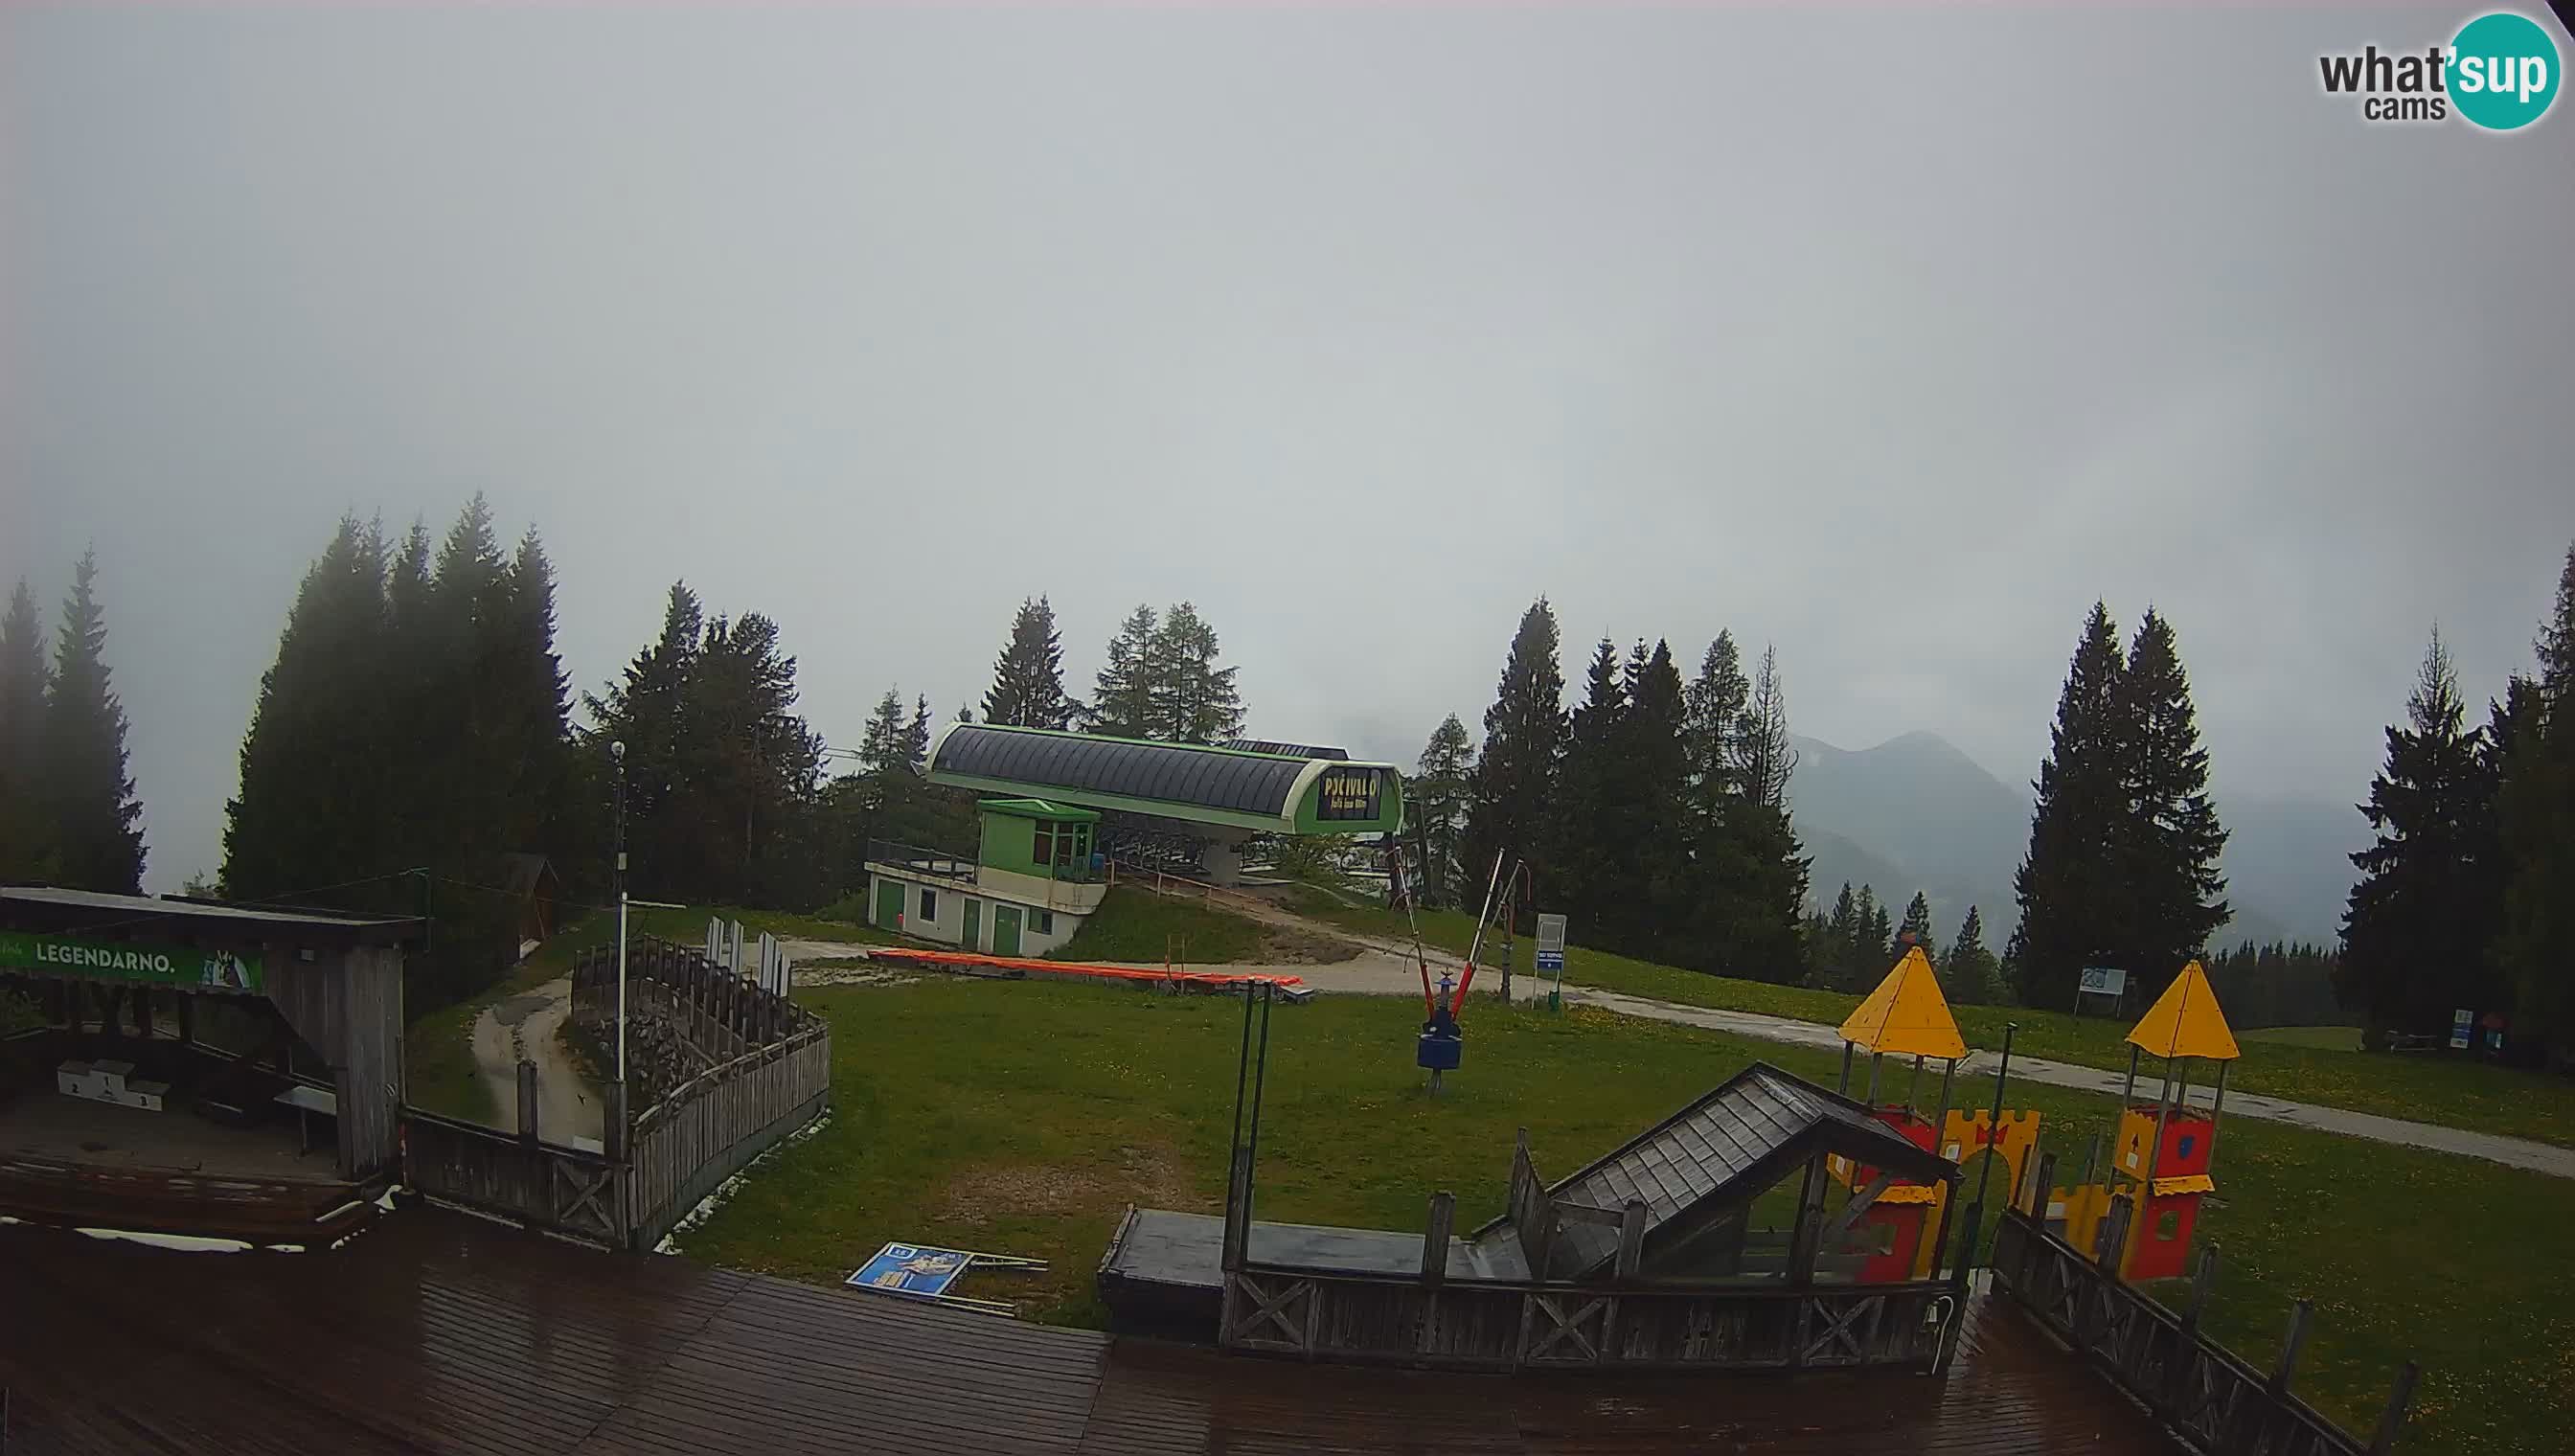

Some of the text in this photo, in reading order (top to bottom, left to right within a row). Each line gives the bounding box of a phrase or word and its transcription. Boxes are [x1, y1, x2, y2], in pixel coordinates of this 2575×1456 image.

[36, 943, 175, 973] LEGENDARNO.
[72, 1082, 79, 1094] 2
[140, 1095, 148, 1106] 3
